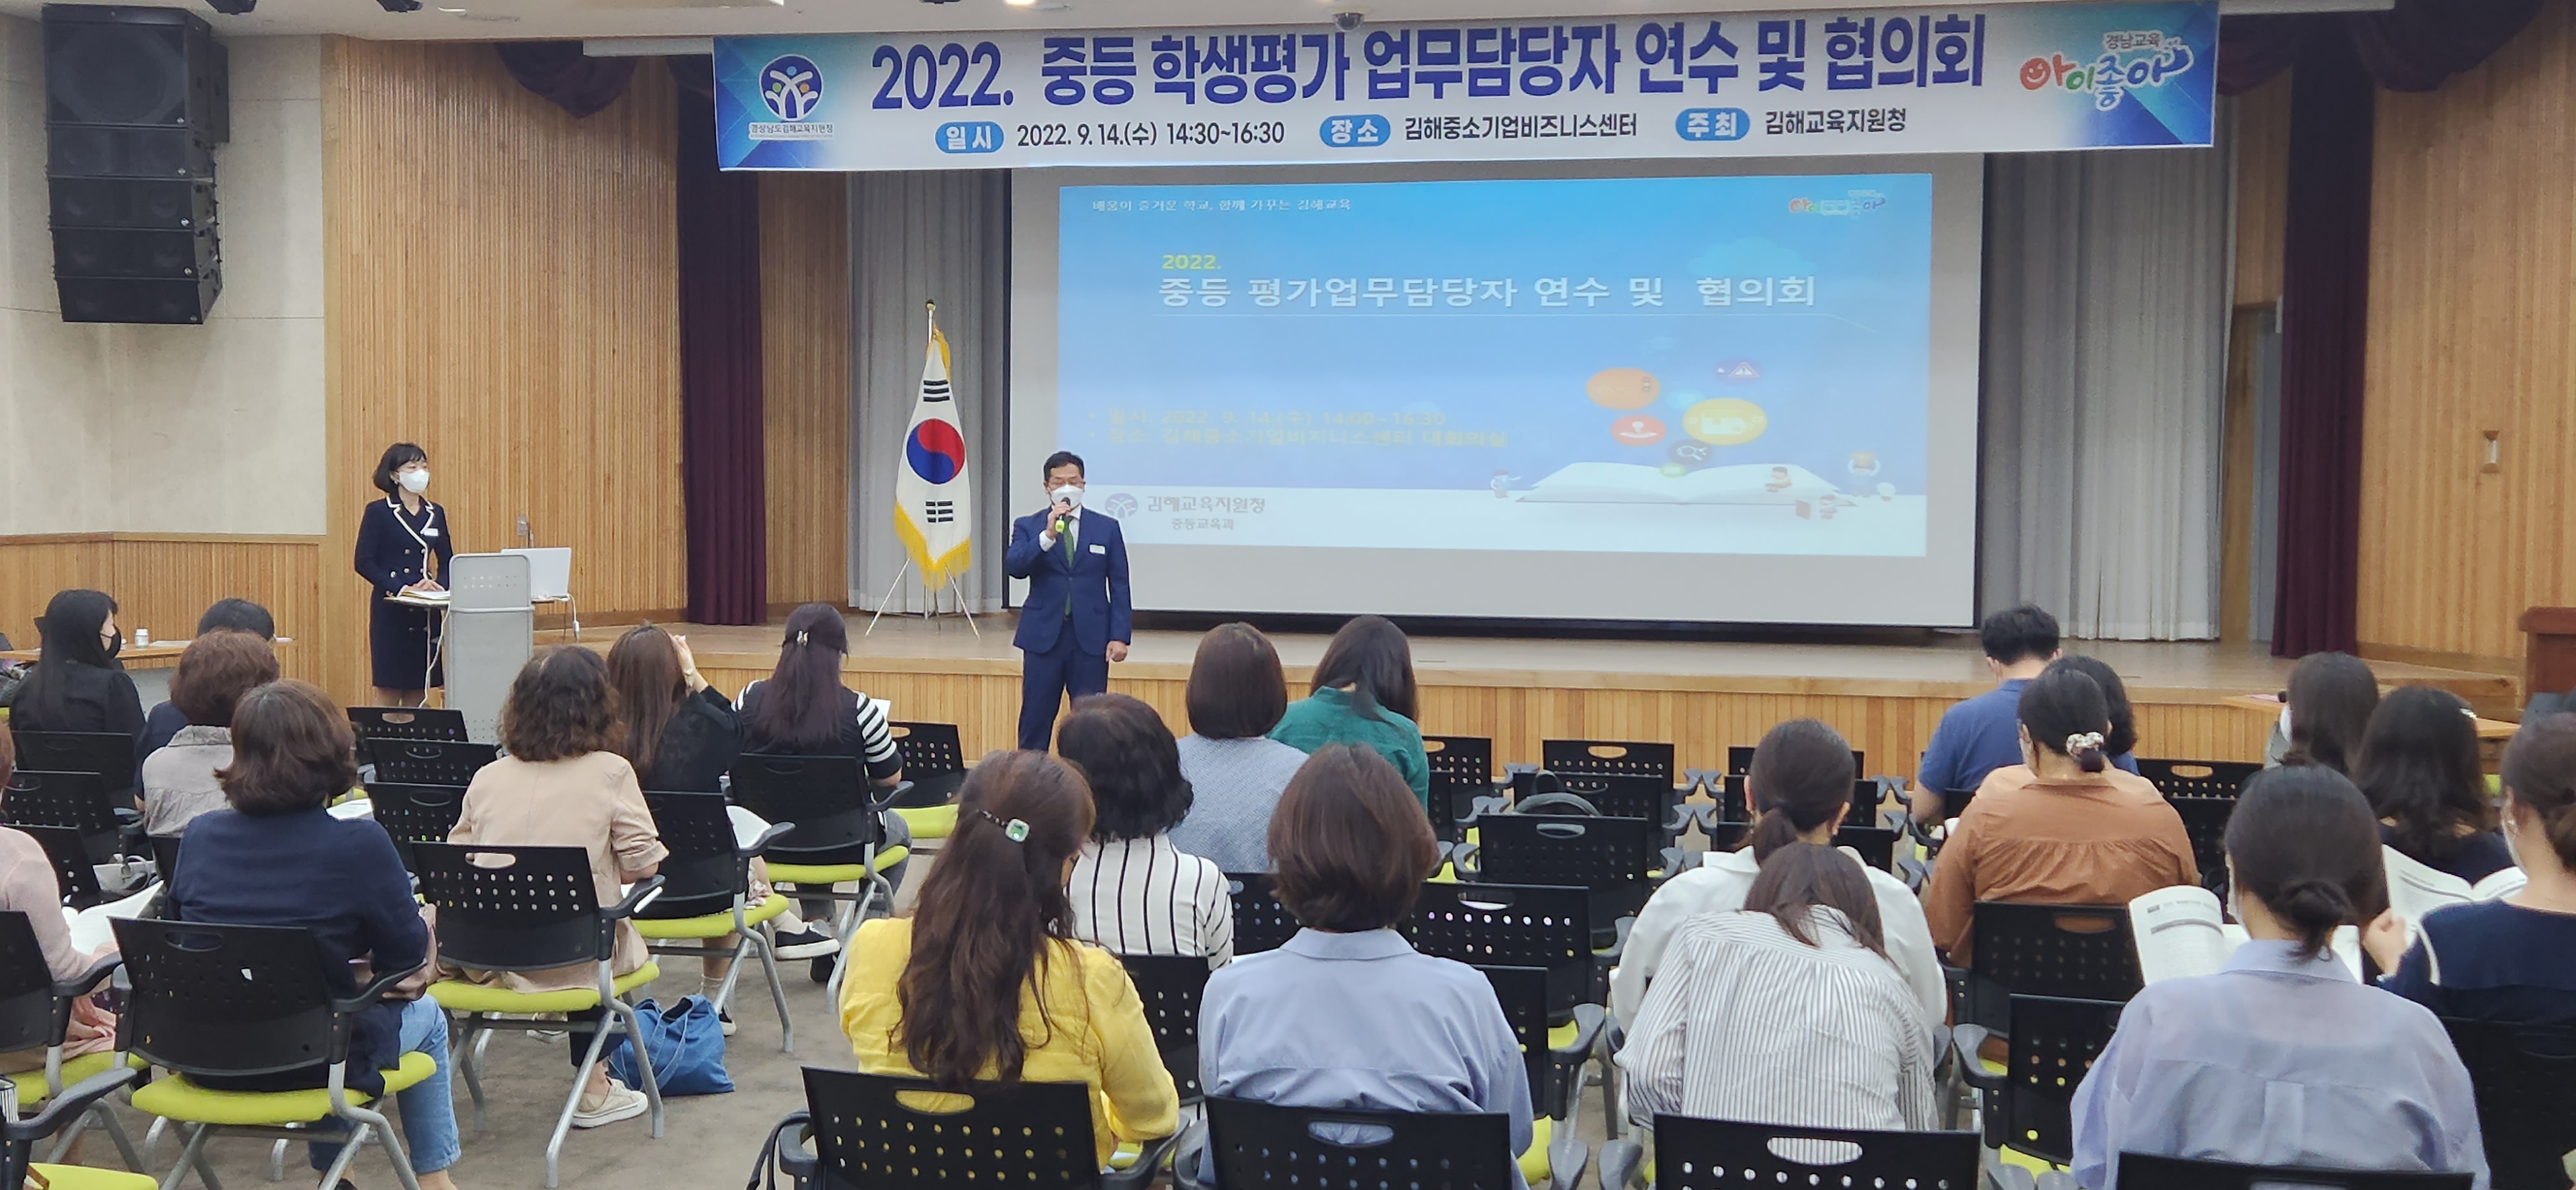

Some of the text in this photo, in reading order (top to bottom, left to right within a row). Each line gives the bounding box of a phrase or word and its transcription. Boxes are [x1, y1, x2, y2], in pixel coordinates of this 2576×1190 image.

[2106, 32, 2160, 50] 경남교육
[872, 14, 1986, 109] 2022. 중등 학생평가 업무담당자 연수 및 협의회
[1017, 123, 1072, 147] 2022.
[1166, 121, 1285, 145] 14:30~16:30
[1405, 113, 1637, 140] 김해중소기업비즈니스센터
[1765, 108, 1907, 135] 김해교육지원청
[1093, 200, 1132, 212] 배움이
[1139, 200, 1177, 212] 즐거운
[1251, 199, 1291, 211] 가꾸는
[1298, 198, 1351, 211] 김해교육
[1162, 254, 1222, 270] 2022.
[1159, 276, 1815, 308] 중등 평가업무담당자 연수 및 협의회
[1147, 496, 1265, 514] 김해교육지원청
